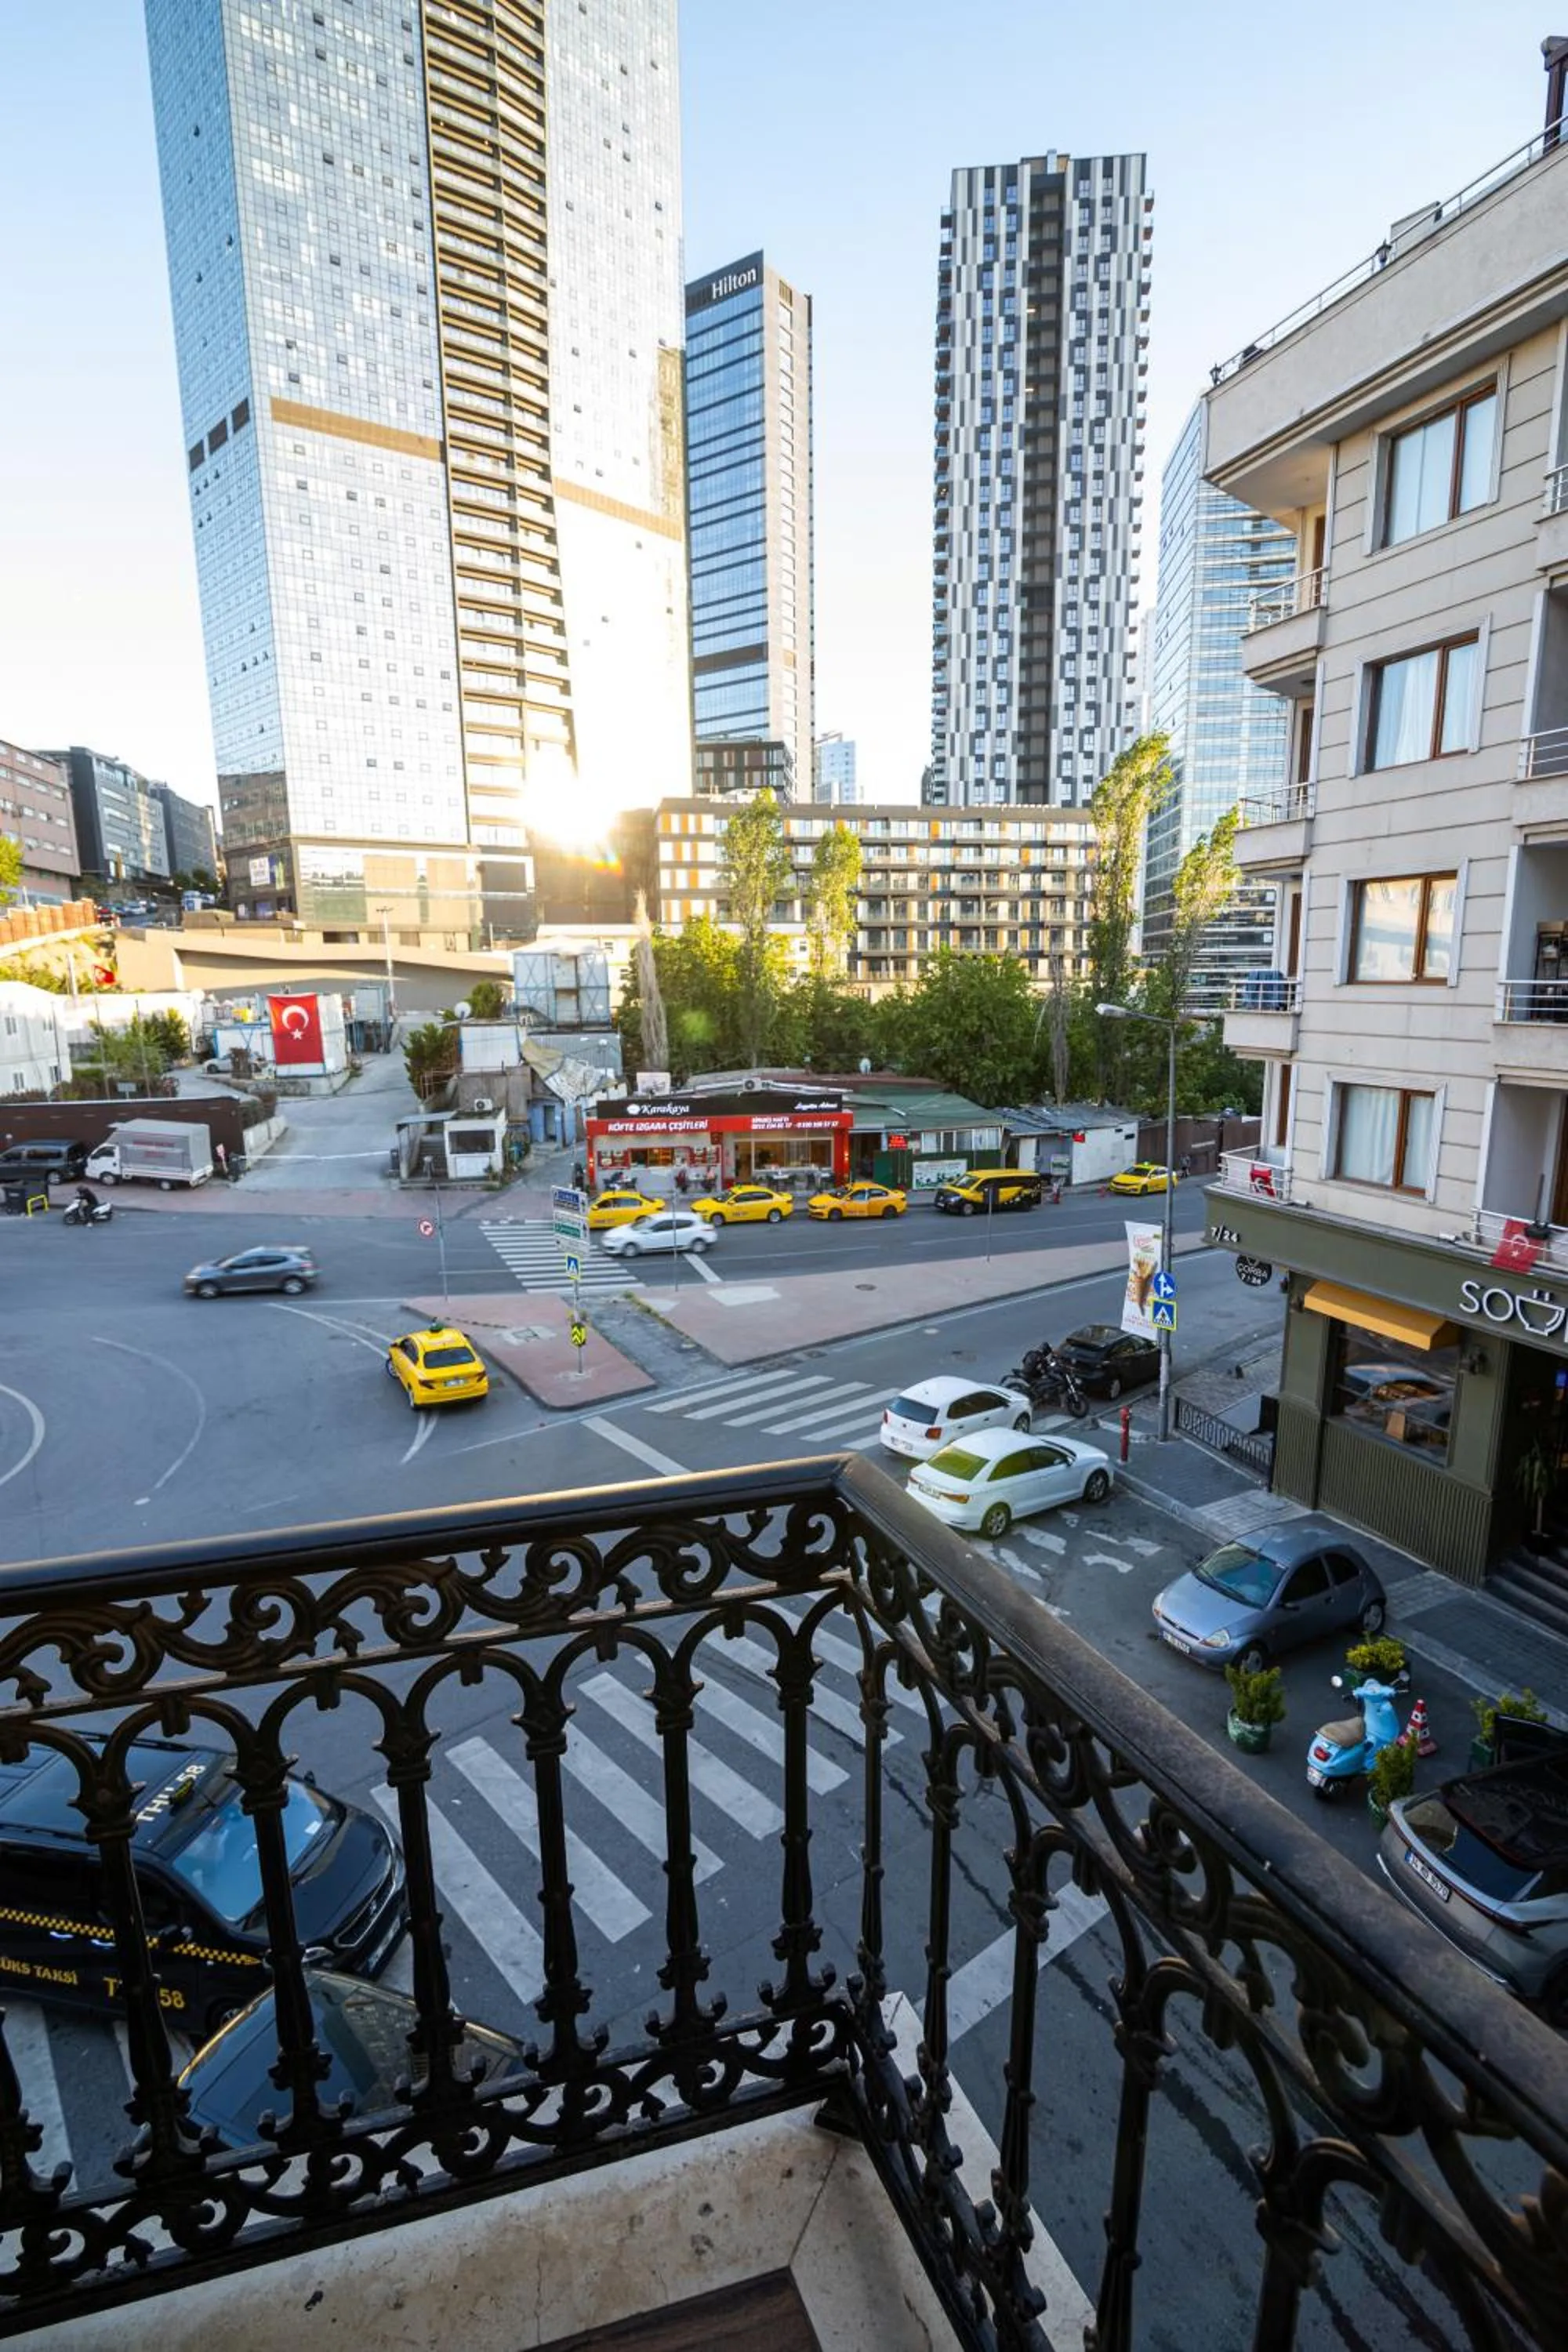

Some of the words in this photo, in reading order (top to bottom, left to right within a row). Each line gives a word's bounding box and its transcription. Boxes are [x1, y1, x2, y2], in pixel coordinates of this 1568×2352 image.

[713, 268, 757, 299] Hilton
[641, 1102, 690, 1115] Karakaya
[608, 1122, 635, 1132] KÖFTE
[1210, 1225, 1238, 1243] 7/24
[0, 1955, 31, 1975] ÜKS
[33, 1964, 78, 1986] TAKSİ
[159, 1987, 185, 2009] 58
